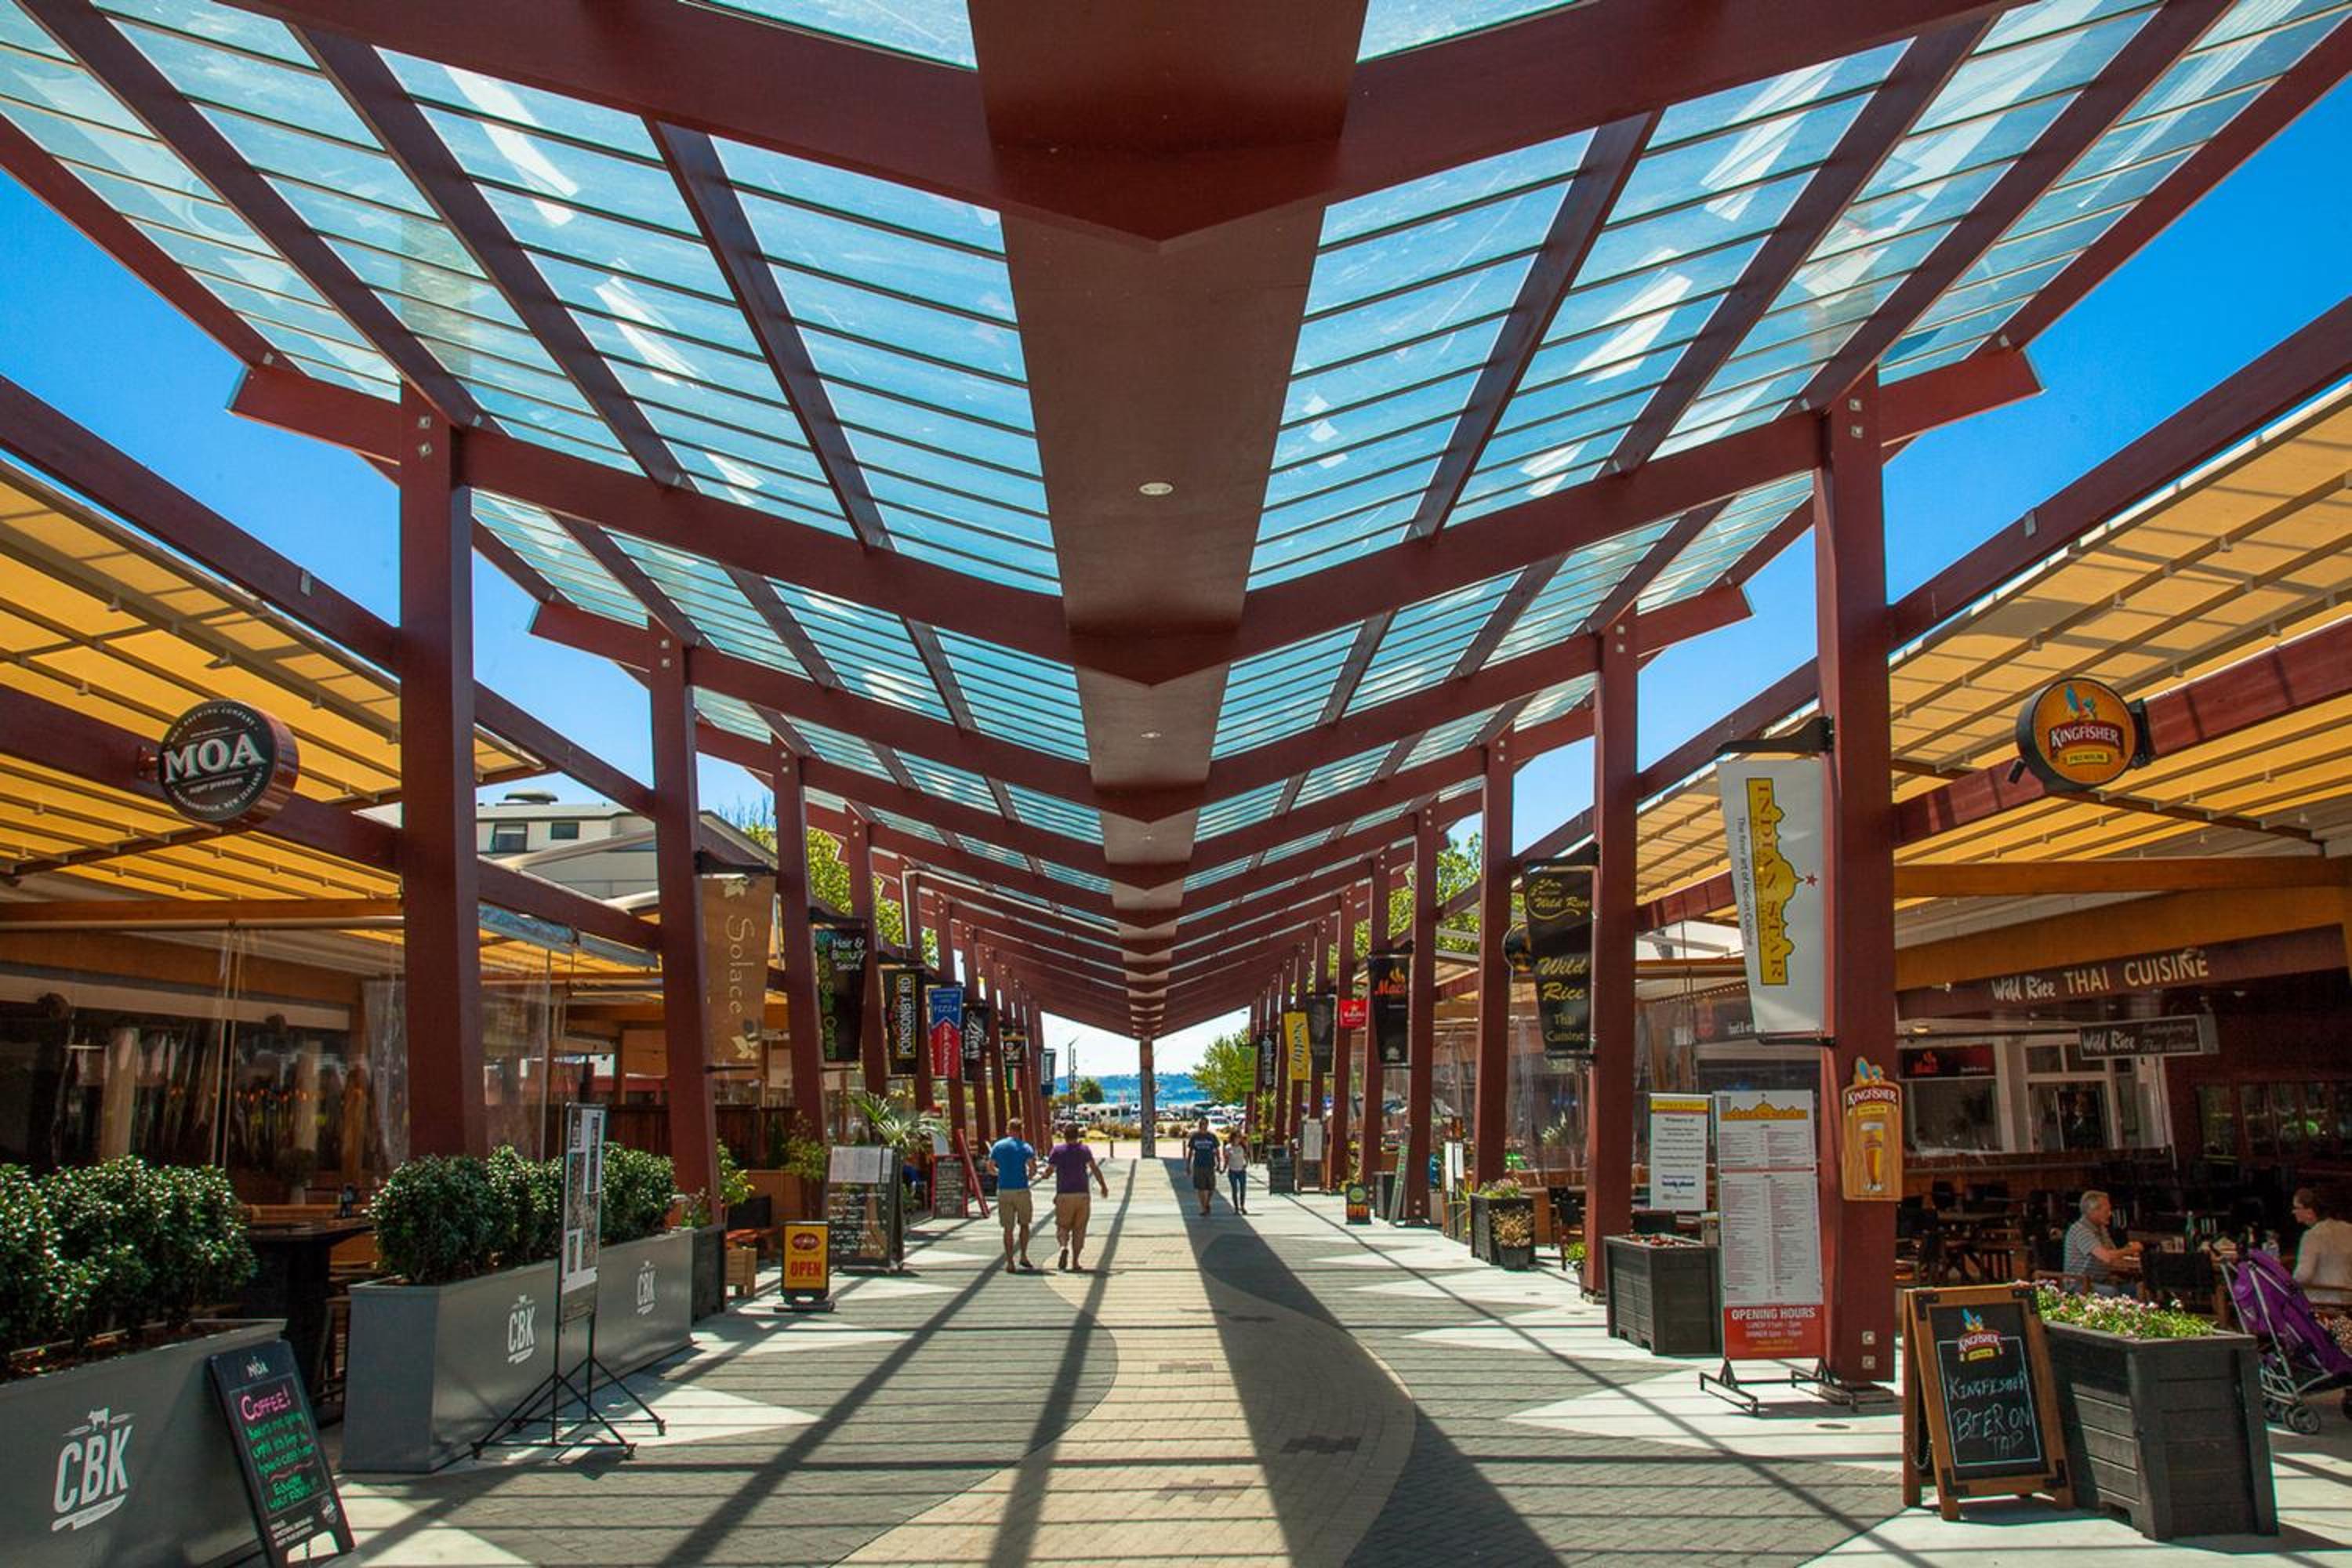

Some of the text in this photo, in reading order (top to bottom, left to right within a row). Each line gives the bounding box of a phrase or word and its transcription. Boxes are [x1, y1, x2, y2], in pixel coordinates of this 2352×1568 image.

[2050, 726, 2121, 748] KINGFISHER
[162, 733, 268, 783] MOA
[1737, 817, 1746, 833] The
[1740, 857, 1748, 869] art
[1740, 870, 1749, 882] of
[1757, 786, 1783, 978] INDIAN STAR
[725, 915, 755, 1015] Solace
[1537, 956, 1588, 976] Wild
[1991, 954, 2209, 1003] Wild Rice THAI CUISINE
[1541, 982, 1585, 1001] Rice
[900, 977, 912, 1054] PONSONBY RD
[1555, 1013, 1577, 1025] Thai
[1545, 1029, 1585, 1042] Cuisine
[2082, 1029, 2135, 1052] Wild Rice
[1847, 1088, 1896, 1105] KINGFISHER
[790, 1261, 822, 1278] OPEN
[637, 1270, 655, 1306] CBK
[1731, 1307, 1816, 1320] OPENING HOURS
[508, 1306, 535, 1354] CBK
[1958, 1334, 1999, 1353] KINGFISHER
[241, 1383, 292, 1421] COFFEE!
[1953, 1403, 2031, 1443] BEER ON
[53, 1425, 133, 1515] CBK
